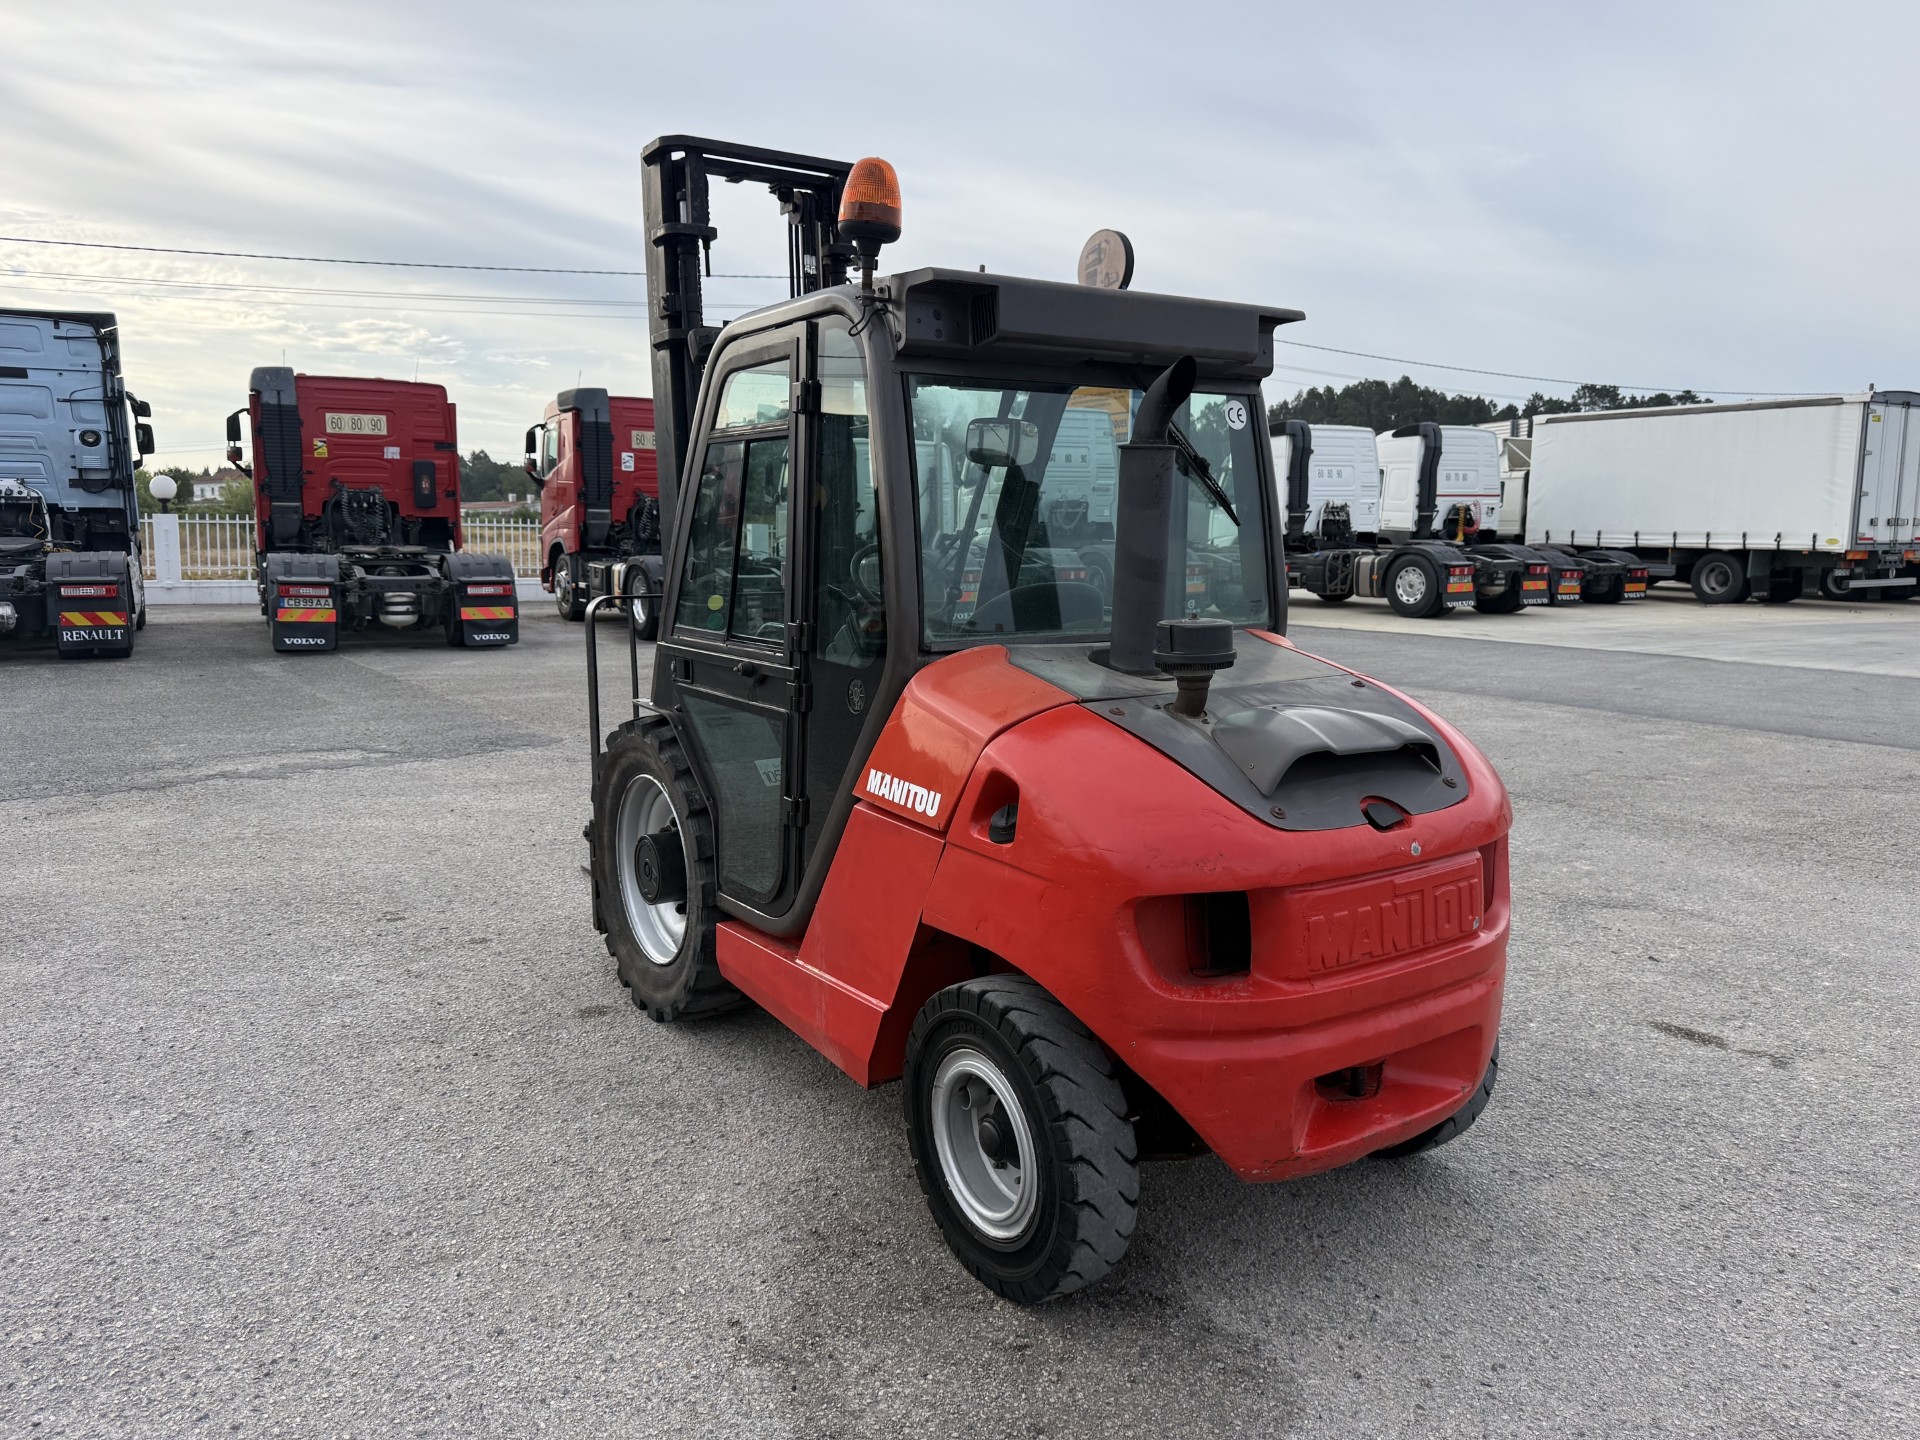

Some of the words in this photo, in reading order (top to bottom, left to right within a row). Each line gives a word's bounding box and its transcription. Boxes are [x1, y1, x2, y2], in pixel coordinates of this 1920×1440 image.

[1227, 407, 1245, 424] CE
[330, 417, 343, 430] 60
[350, 417, 363, 431] 80
[370, 418, 382, 432] 90
[635, 433, 646, 446] 60
[1446, 600, 1475, 608] VOLVO
[62, 629, 124, 642] RENAULT
[282, 637, 326, 645] VOLVO
[472, 633, 511, 641] VOLVO
[866, 768, 942, 817] MANITOU
[1306, 860, 1480, 972] MANITOU
